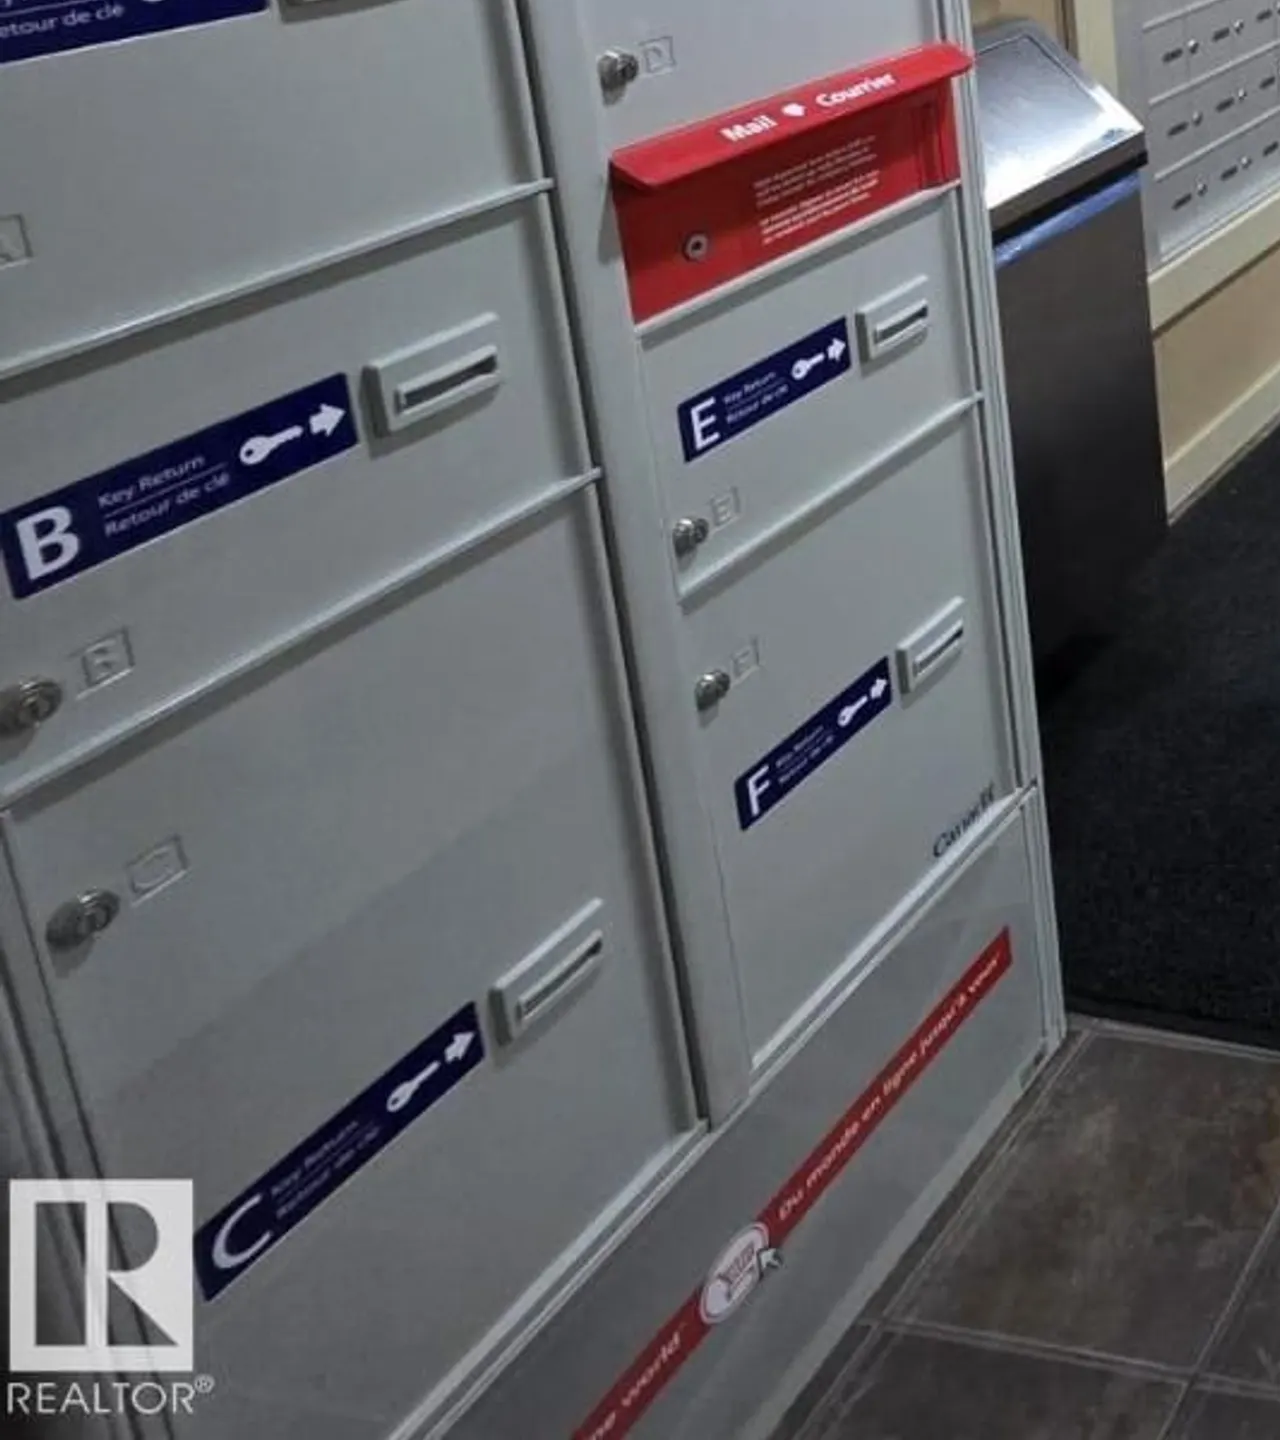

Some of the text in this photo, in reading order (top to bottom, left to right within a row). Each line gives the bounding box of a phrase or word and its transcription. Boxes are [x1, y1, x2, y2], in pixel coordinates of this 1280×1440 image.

[62, 9, 91, 27] de
[721, 73, 896, 141] Mail Courrier
[691, 397, 720, 450] E
[98, 456, 205, 508] Key Return
[104, 500, 170, 537] Retour
[176, 486, 200, 505] de
[15, 505, 80, 580] B
[747, 764, 772, 816] F
[779, 1189, 804, 1221] Du
[806, 1121, 860, 1187] monde
[212, 1193, 274, 1269] C
